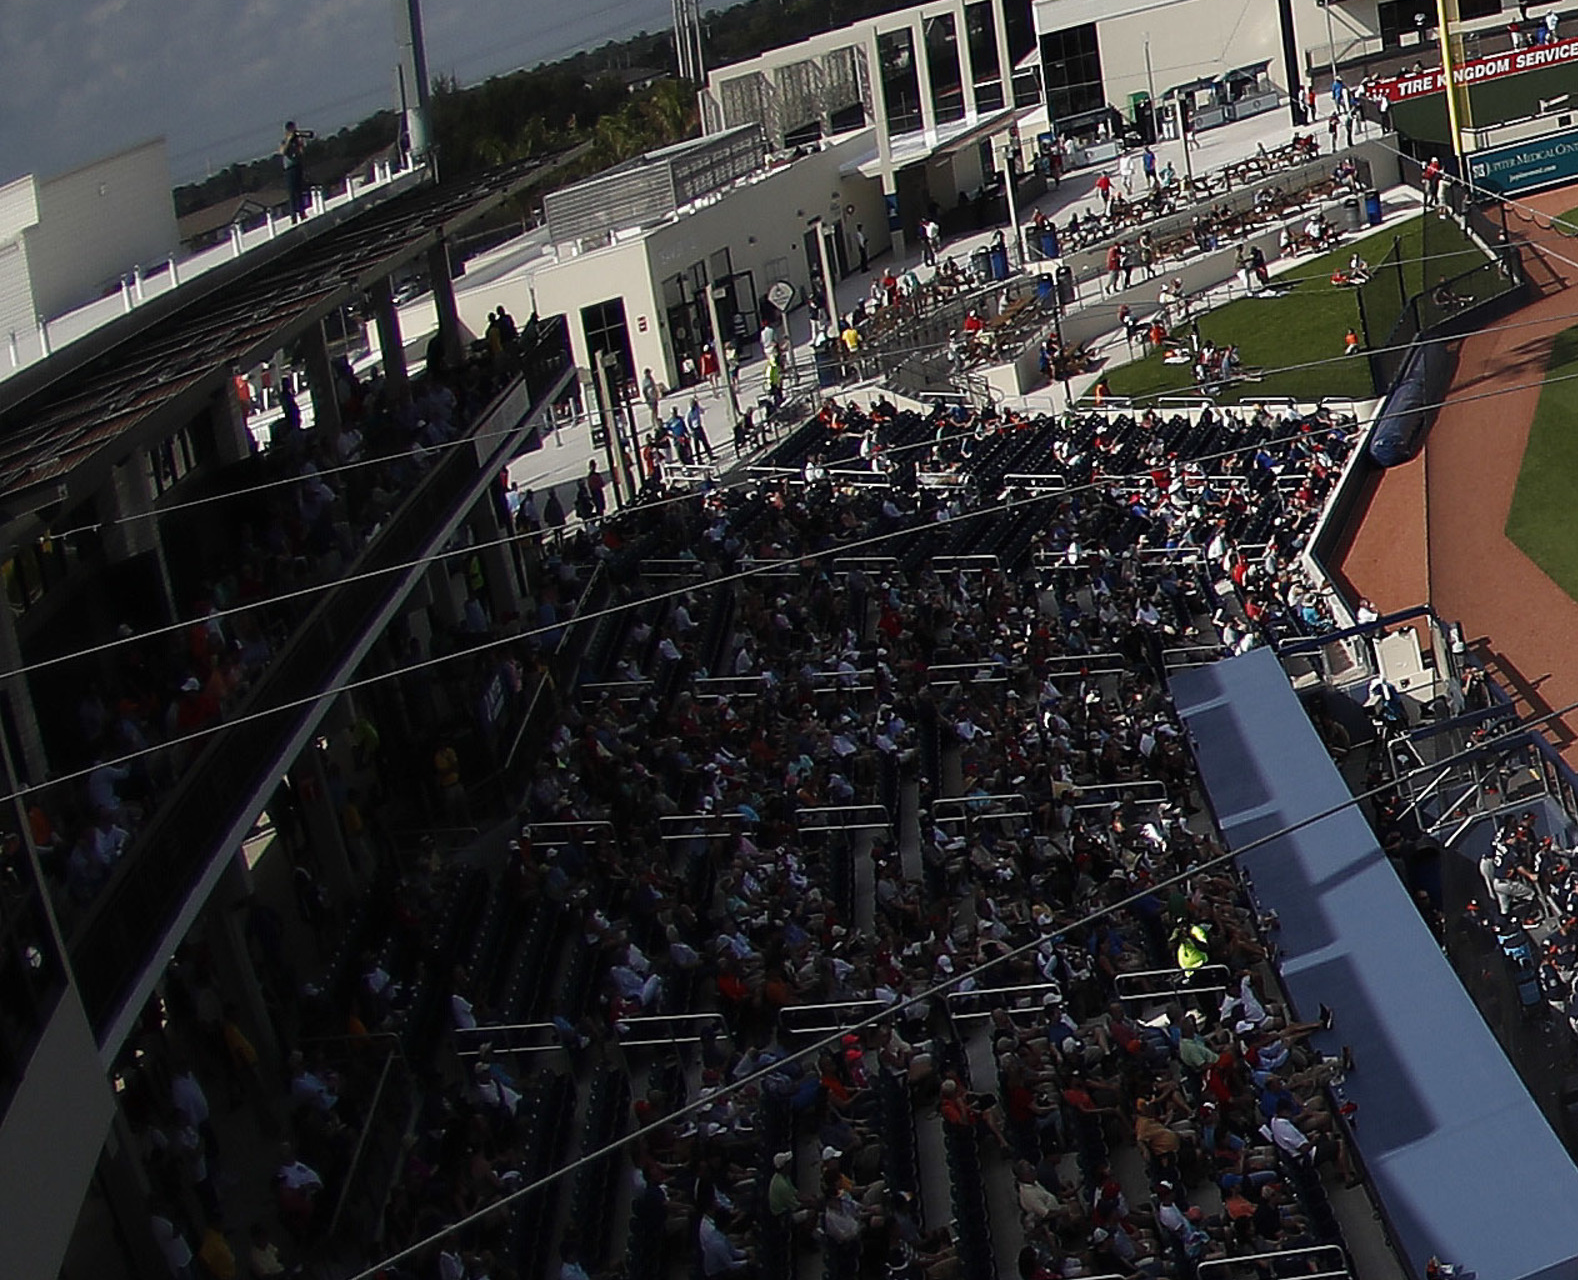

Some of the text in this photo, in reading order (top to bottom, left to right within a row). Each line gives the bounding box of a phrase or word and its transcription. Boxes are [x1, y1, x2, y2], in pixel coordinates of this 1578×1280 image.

[1397, 75, 1433, 96] TIRE
[1437, 58, 1510, 87] KNGDOM
[1516, 41, 1578, 68] SERVICE
